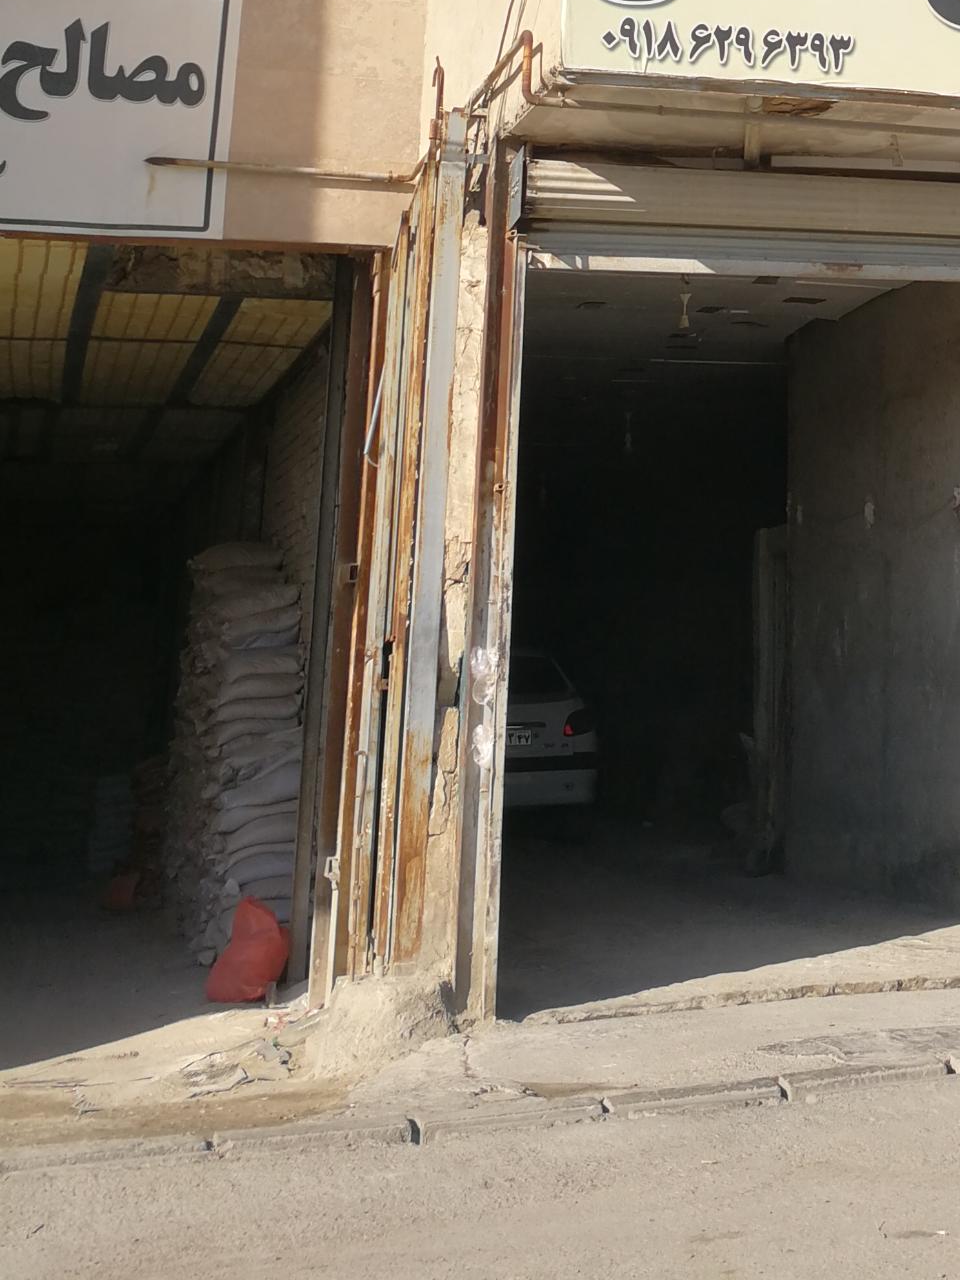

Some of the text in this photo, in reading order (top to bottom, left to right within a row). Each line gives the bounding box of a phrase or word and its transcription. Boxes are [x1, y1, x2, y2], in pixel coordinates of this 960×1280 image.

[0, 17, 205, 120] مصالح
[602, 16, 853, 71] ۰۹۱۸ ۶۲۹ ۶۳۹۳
